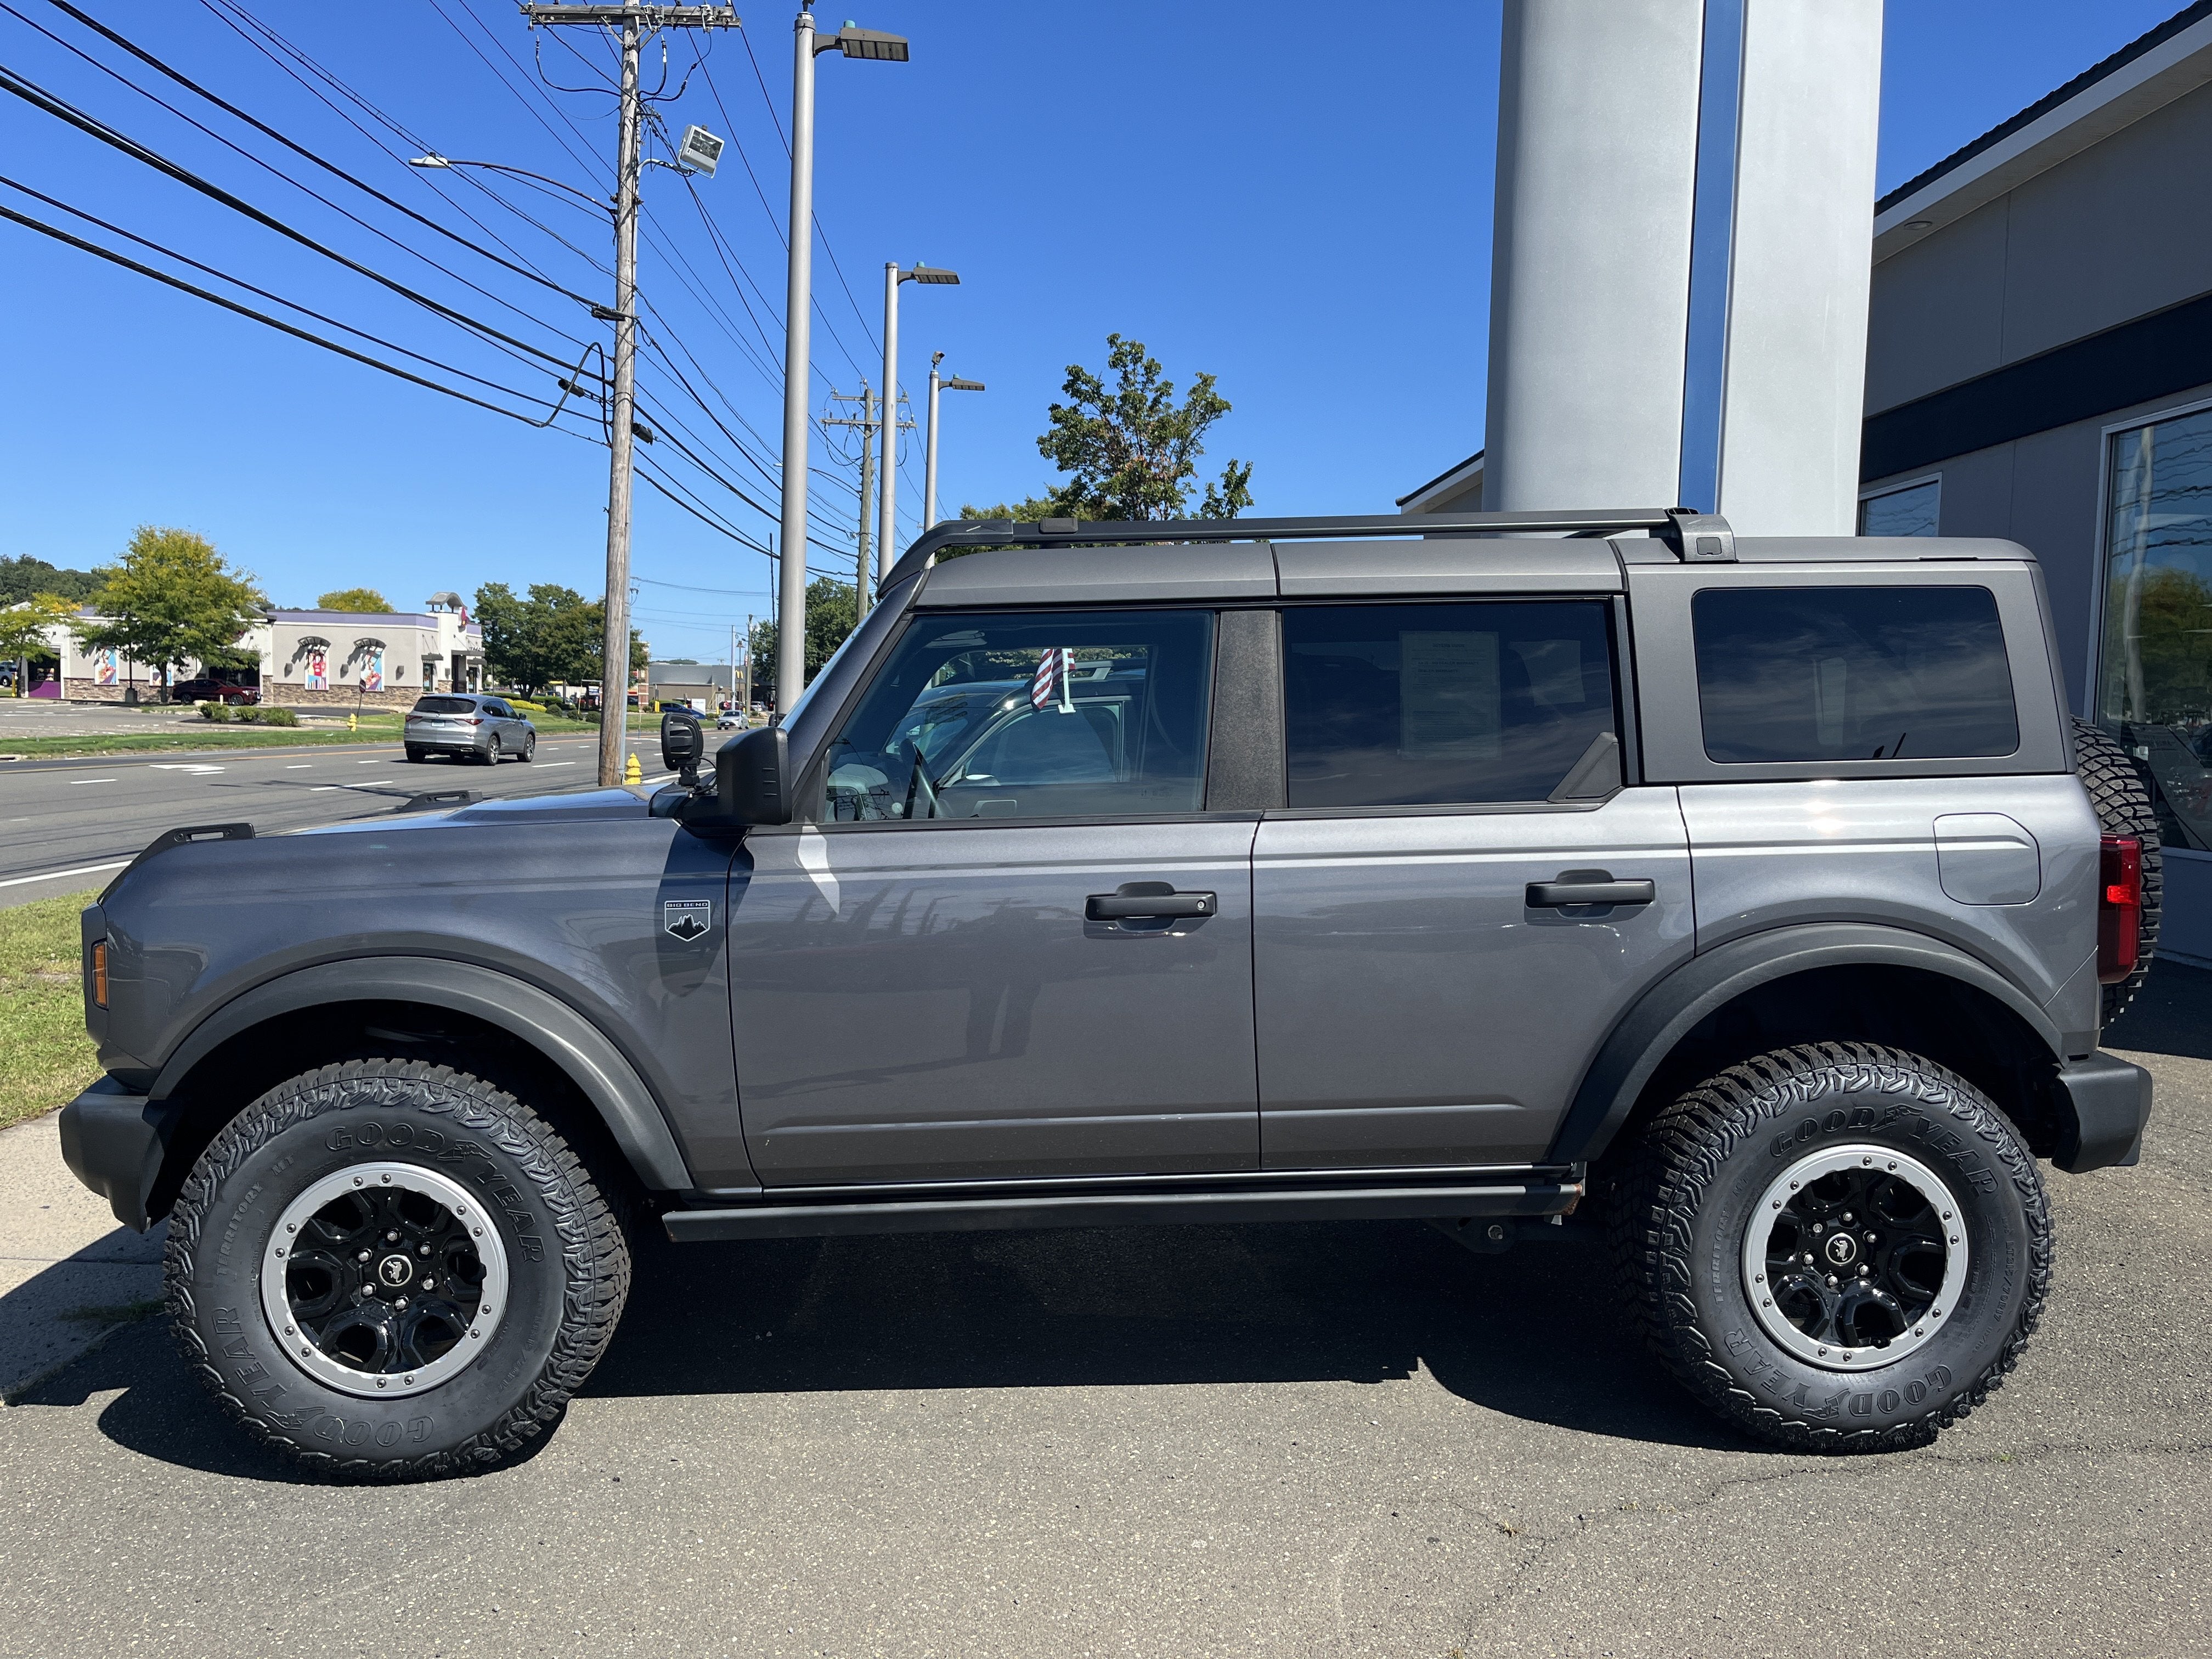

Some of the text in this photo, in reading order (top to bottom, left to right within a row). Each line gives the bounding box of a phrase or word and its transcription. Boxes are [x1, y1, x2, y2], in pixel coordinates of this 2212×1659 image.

[217, 1155, 295, 1276] TERRITORY MT
[1712, 1208, 1729, 1304] TERRITORY
